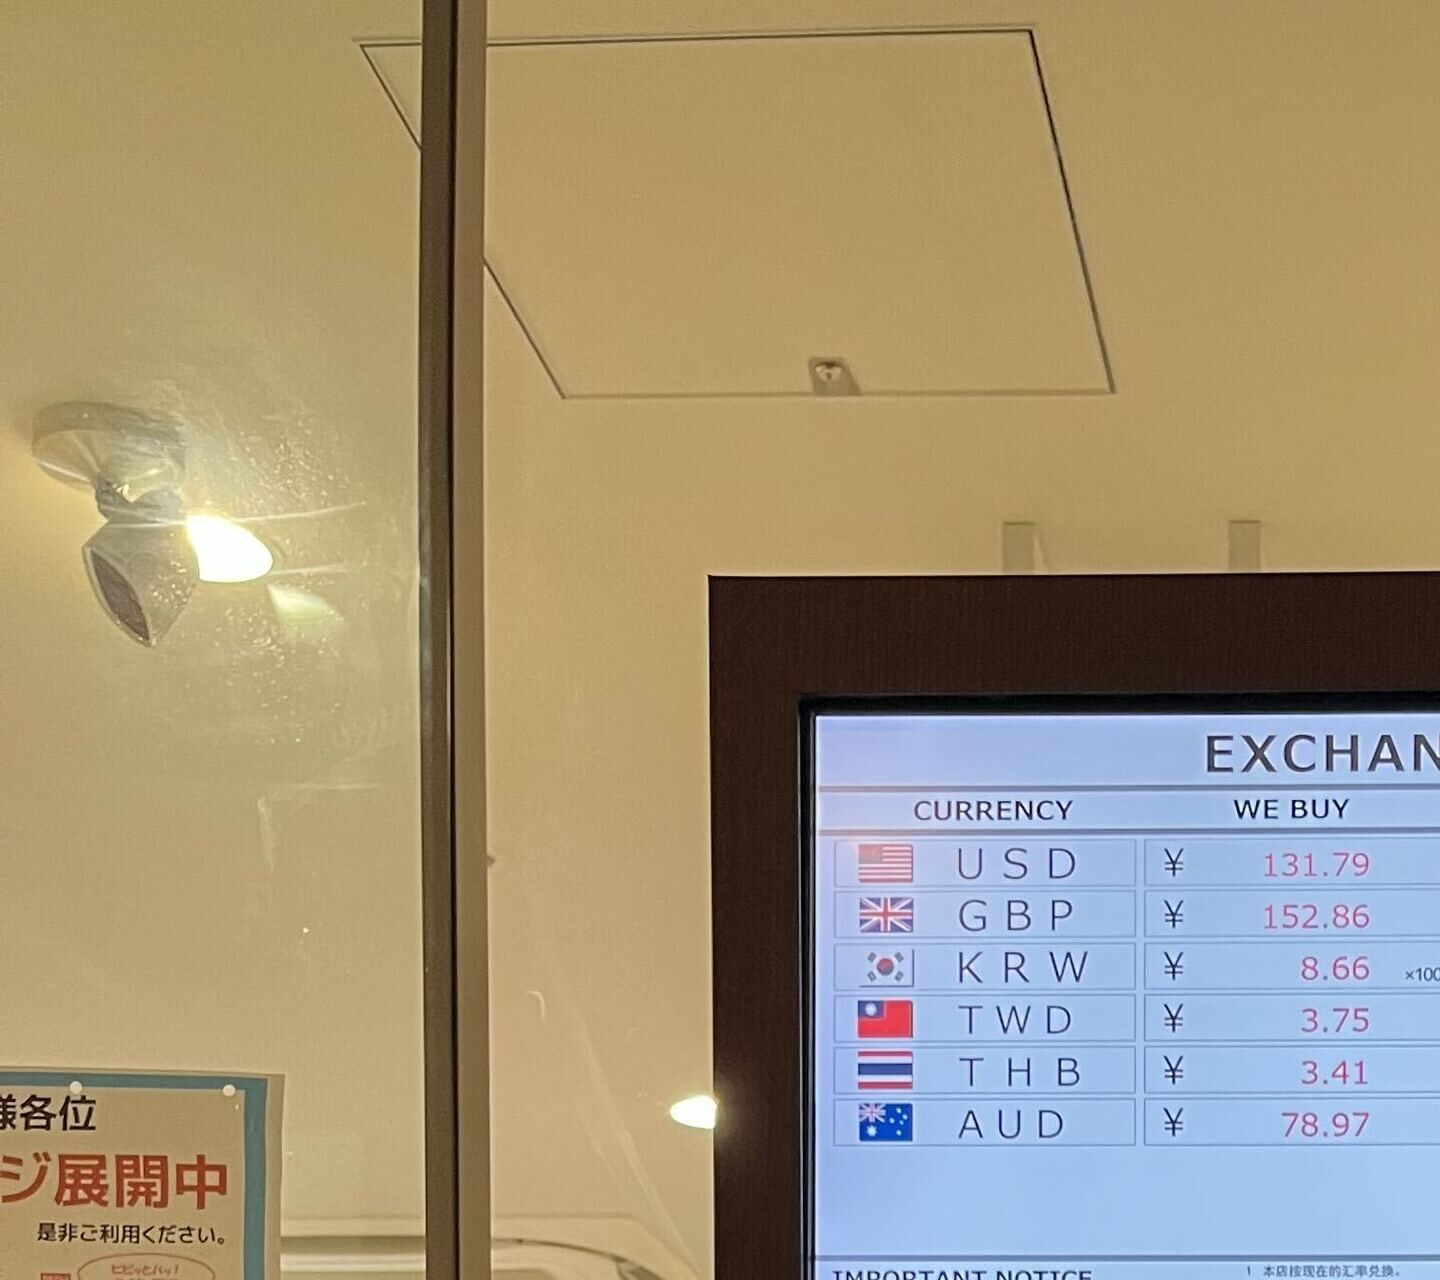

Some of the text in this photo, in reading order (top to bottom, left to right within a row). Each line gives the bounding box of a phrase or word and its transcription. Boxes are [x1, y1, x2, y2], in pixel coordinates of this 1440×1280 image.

[914, 799, 1074, 821] CURRENCY
[1234, 799, 1350, 820] WE BUY
[957, 847, 1077, 881] USD
[1264, 852, 1370, 878] 131.79
[958, 899, 1074, 932] GBP
[1264, 904, 1370, 930] 152.86
[959, 951, 1088, 984] KRW
[1301, 956, 1370, 981] 8.66
[958, 1004, 1072, 1035] TWD
[1301, 1008, 1370, 1033] 3.75
[958, 1056, 1081, 1087] THB
[1301, 1060, 1369, 1085] 3.41
[958, 1108, 1065, 1139] AUD
[1281, 1112, 1370, 1137] 78.97
[37, 1222, 226, 1246] 是非ご利用ください。
